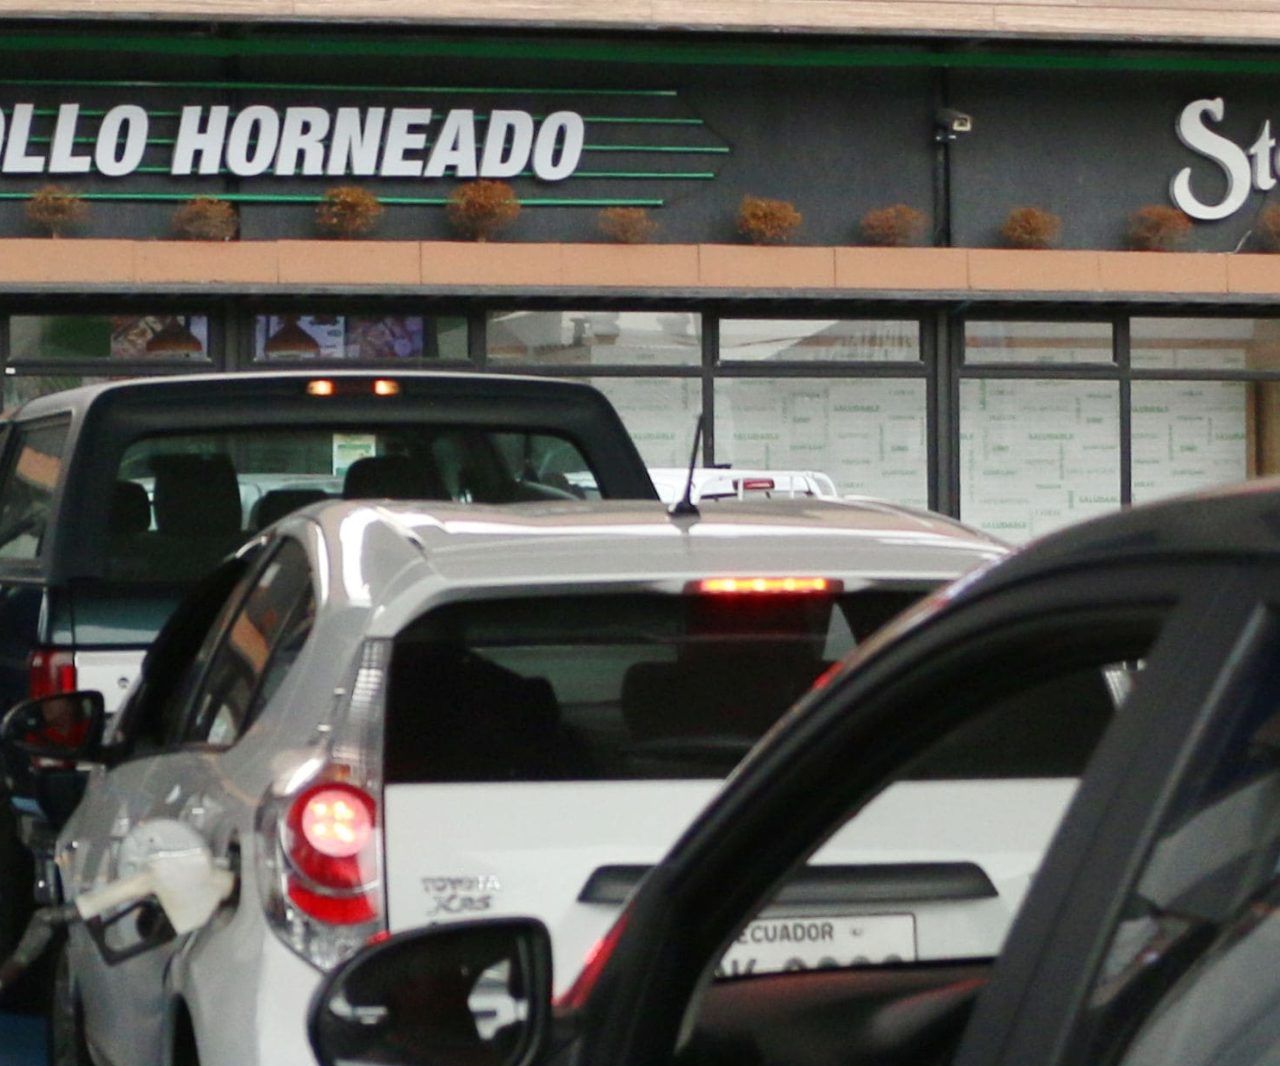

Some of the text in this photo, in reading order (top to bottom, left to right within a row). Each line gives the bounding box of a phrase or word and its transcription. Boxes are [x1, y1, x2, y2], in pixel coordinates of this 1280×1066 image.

[171, 105, 585, 181] HORNEADO
[1170, 97, 1280, 221] St
[421, 875, 502, 893] TOYOTA
